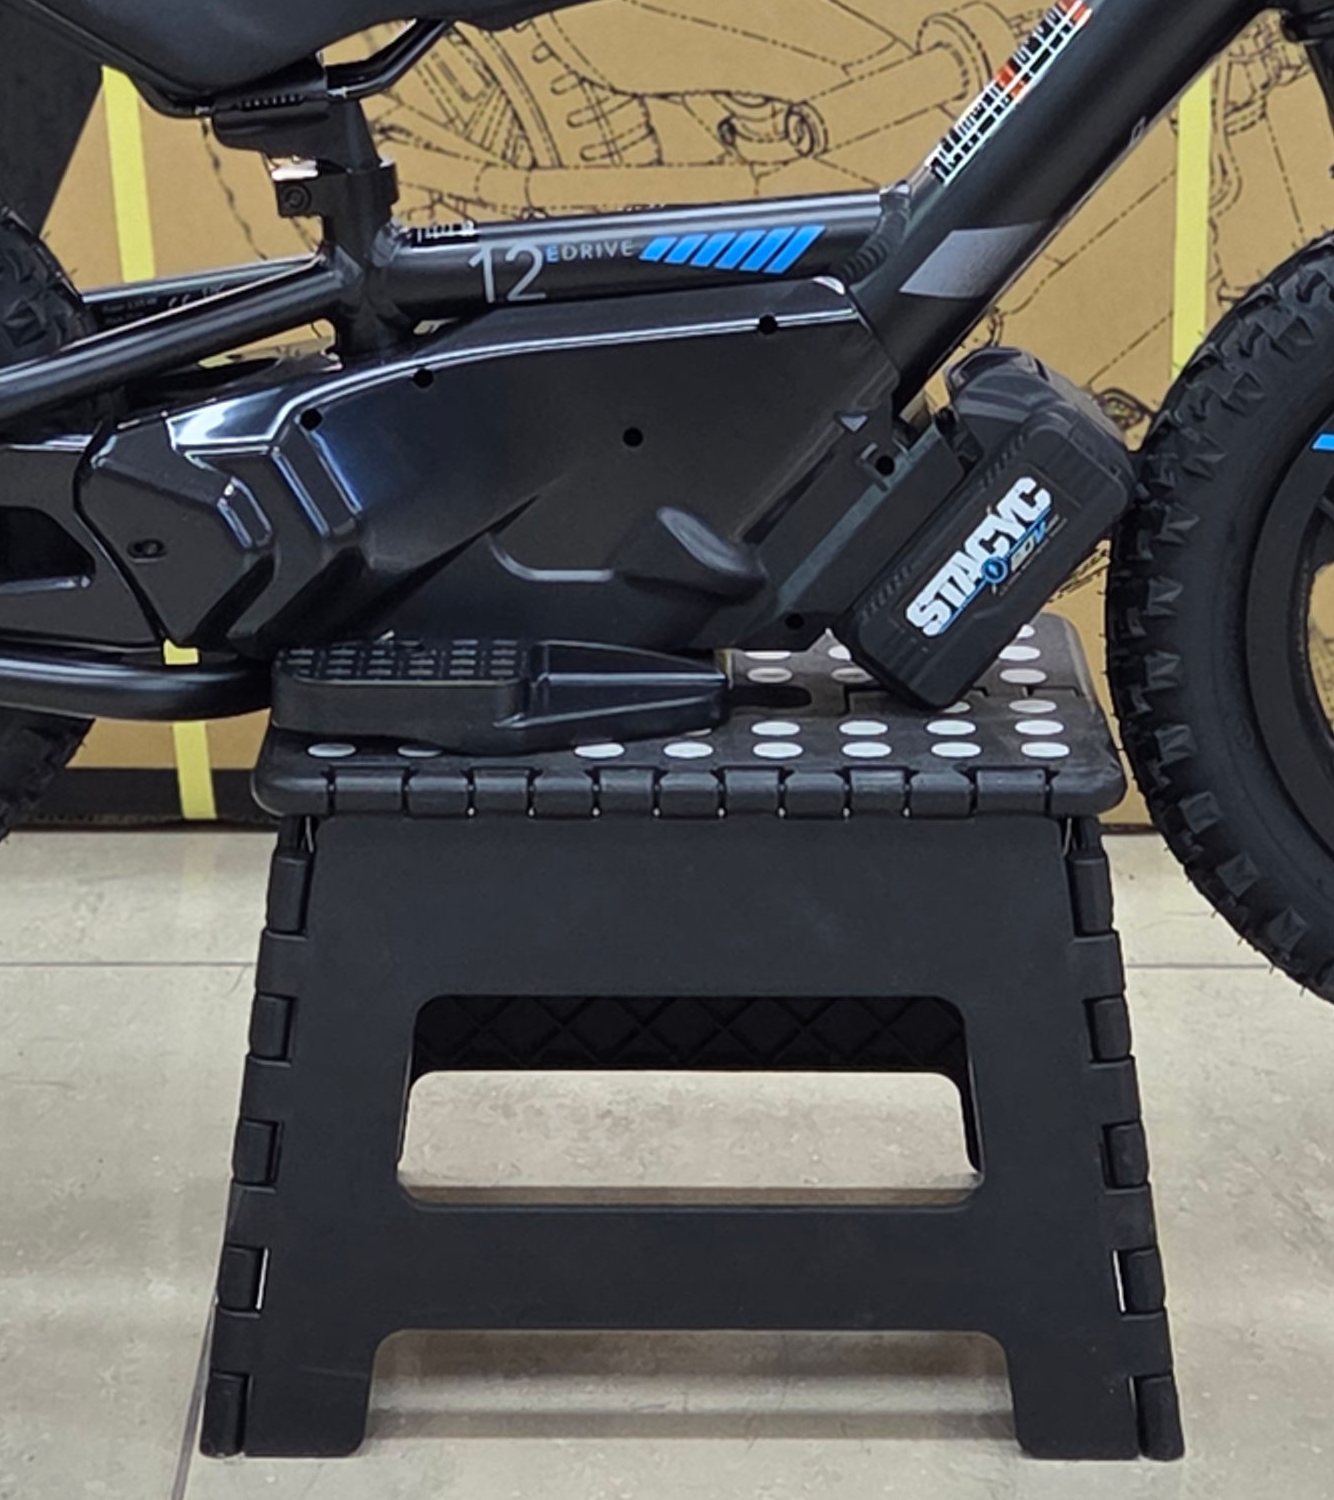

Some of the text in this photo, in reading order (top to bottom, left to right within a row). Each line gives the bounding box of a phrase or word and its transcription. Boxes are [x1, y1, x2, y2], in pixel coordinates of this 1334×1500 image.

[469, 240, 634, 304] 12 EDRIVE
[906, 476, 1052, 636] STACYC
